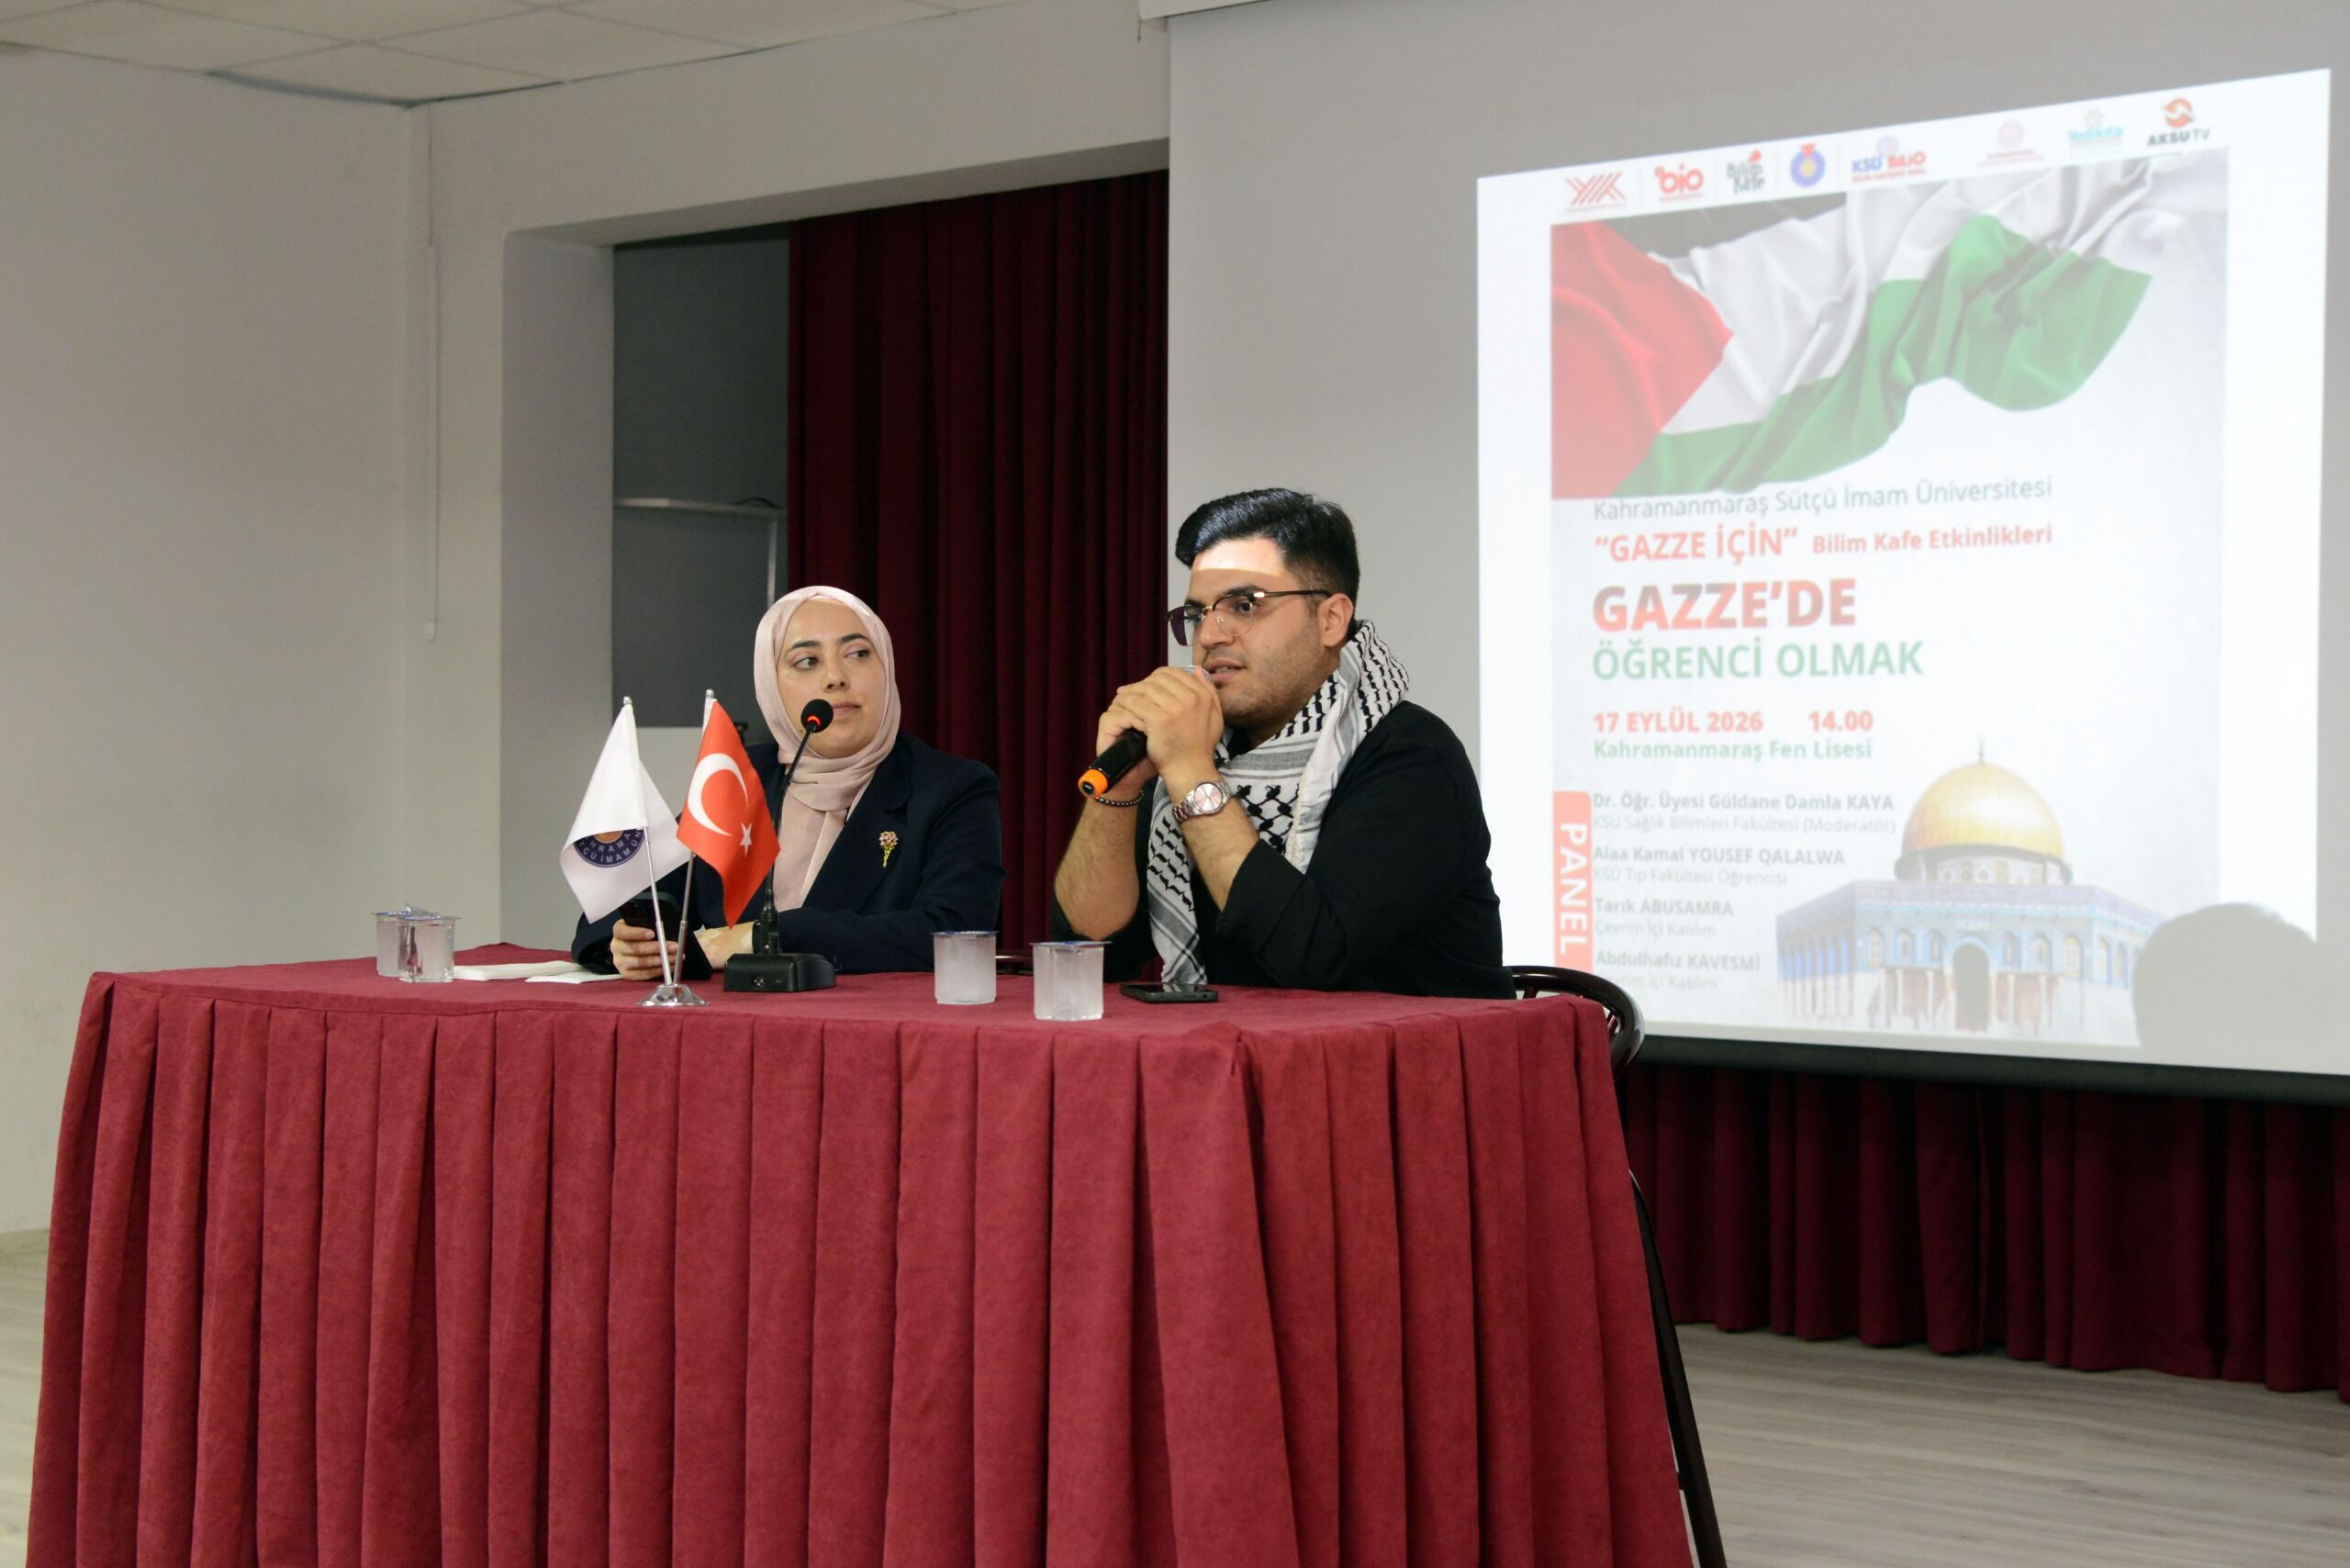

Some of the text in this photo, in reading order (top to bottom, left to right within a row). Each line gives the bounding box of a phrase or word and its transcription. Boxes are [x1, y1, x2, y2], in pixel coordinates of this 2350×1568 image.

[2146, 130, 2191, 147] AKSU
[1653, 162, 1705, 195] bio
[1594, 476, 2053, 520] Kahramanmaraş Sütçü İmam Üniversitesi
[1813, 533, 1867, 554] Bilim
[1874, 530, 1922, 552] Kafe
[1929, 523, 2053, 549] Etkinlikleri
[1592, 635, 1924, 680] ÖĞRENCİ OLMAK
[1594, 705, 1874, 734] 17 EYLÜL 2026 14.00
[1594, 738, 1873, 763] Kahramanmaraş Fen Lisesi
[1593, 790, 1895, 813] Dr. Öğr. Üyesi Güldane Damla KAYA
[1669, 814, 1731, 832] Bilimleri
[1732, 815, 1800, 833] Fakültesi
[1593, 846, 1846, 867] Alaa Kamal YOUSEF QALALWA
[1560, 824, 1588, 956] PANEL
[1639, 901, 1734, 916] ABUSAMRA
[1595, 950, 1683, 969] Abdulhafız
